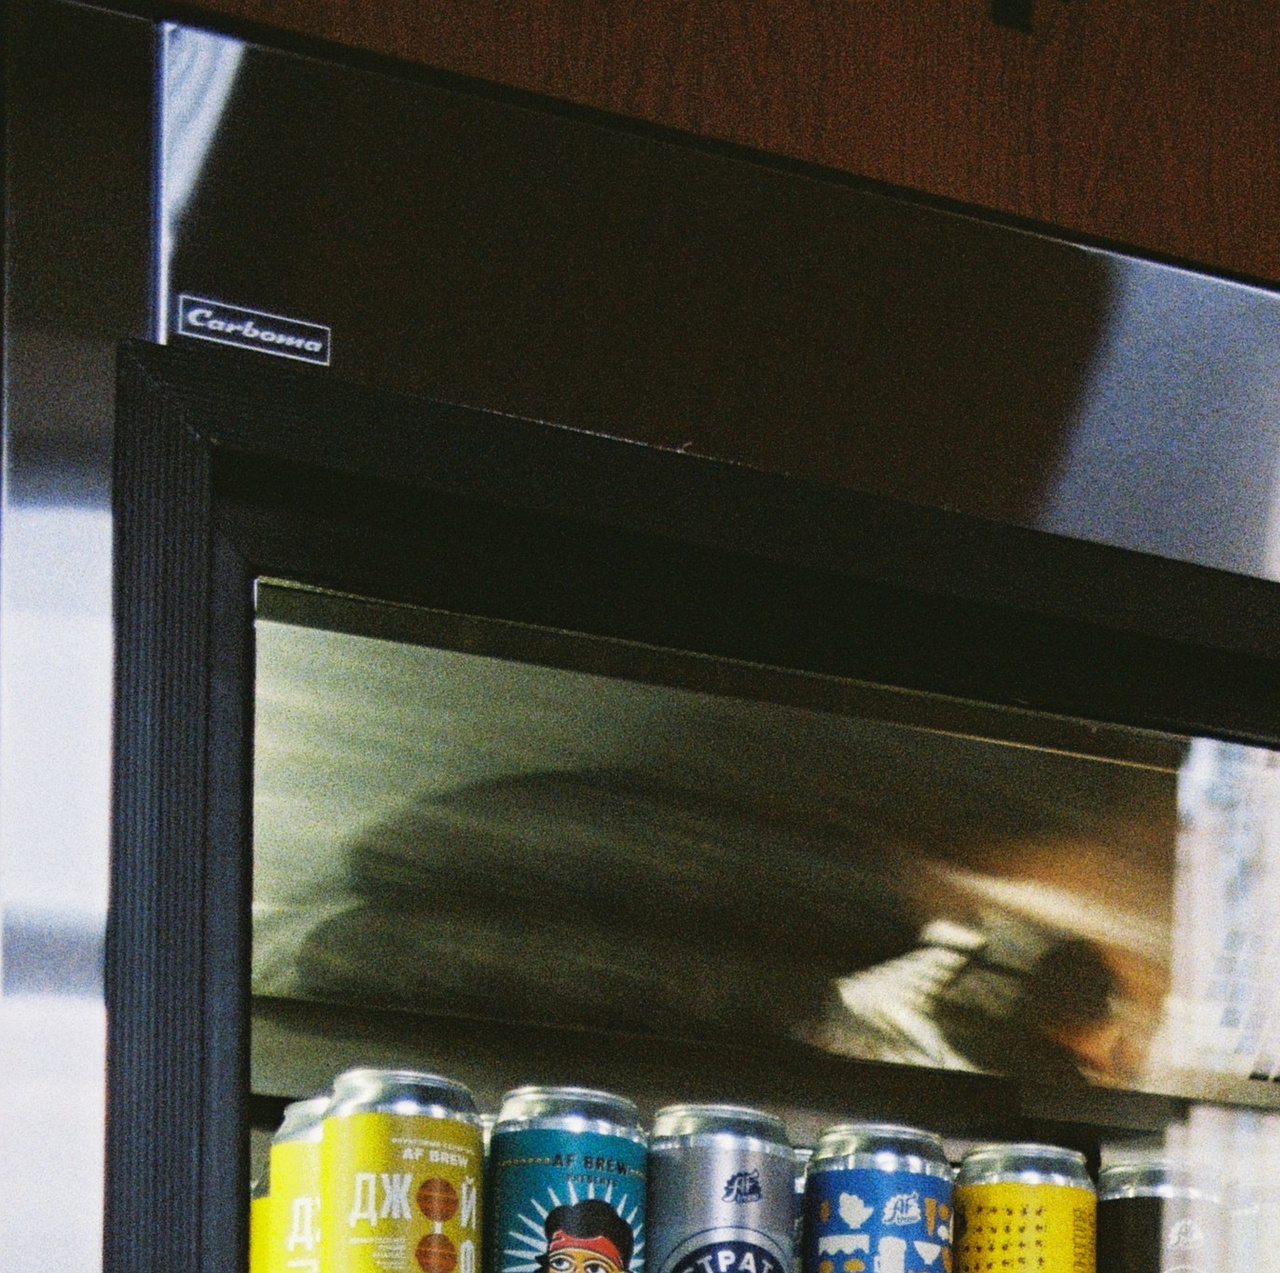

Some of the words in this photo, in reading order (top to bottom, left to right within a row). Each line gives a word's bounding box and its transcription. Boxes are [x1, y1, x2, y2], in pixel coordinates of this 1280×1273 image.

[429, 1150, 468, 1167] BREW
[552, 1154, 574, 1167] AF
[584, 1155, 628, 1175] BREW
